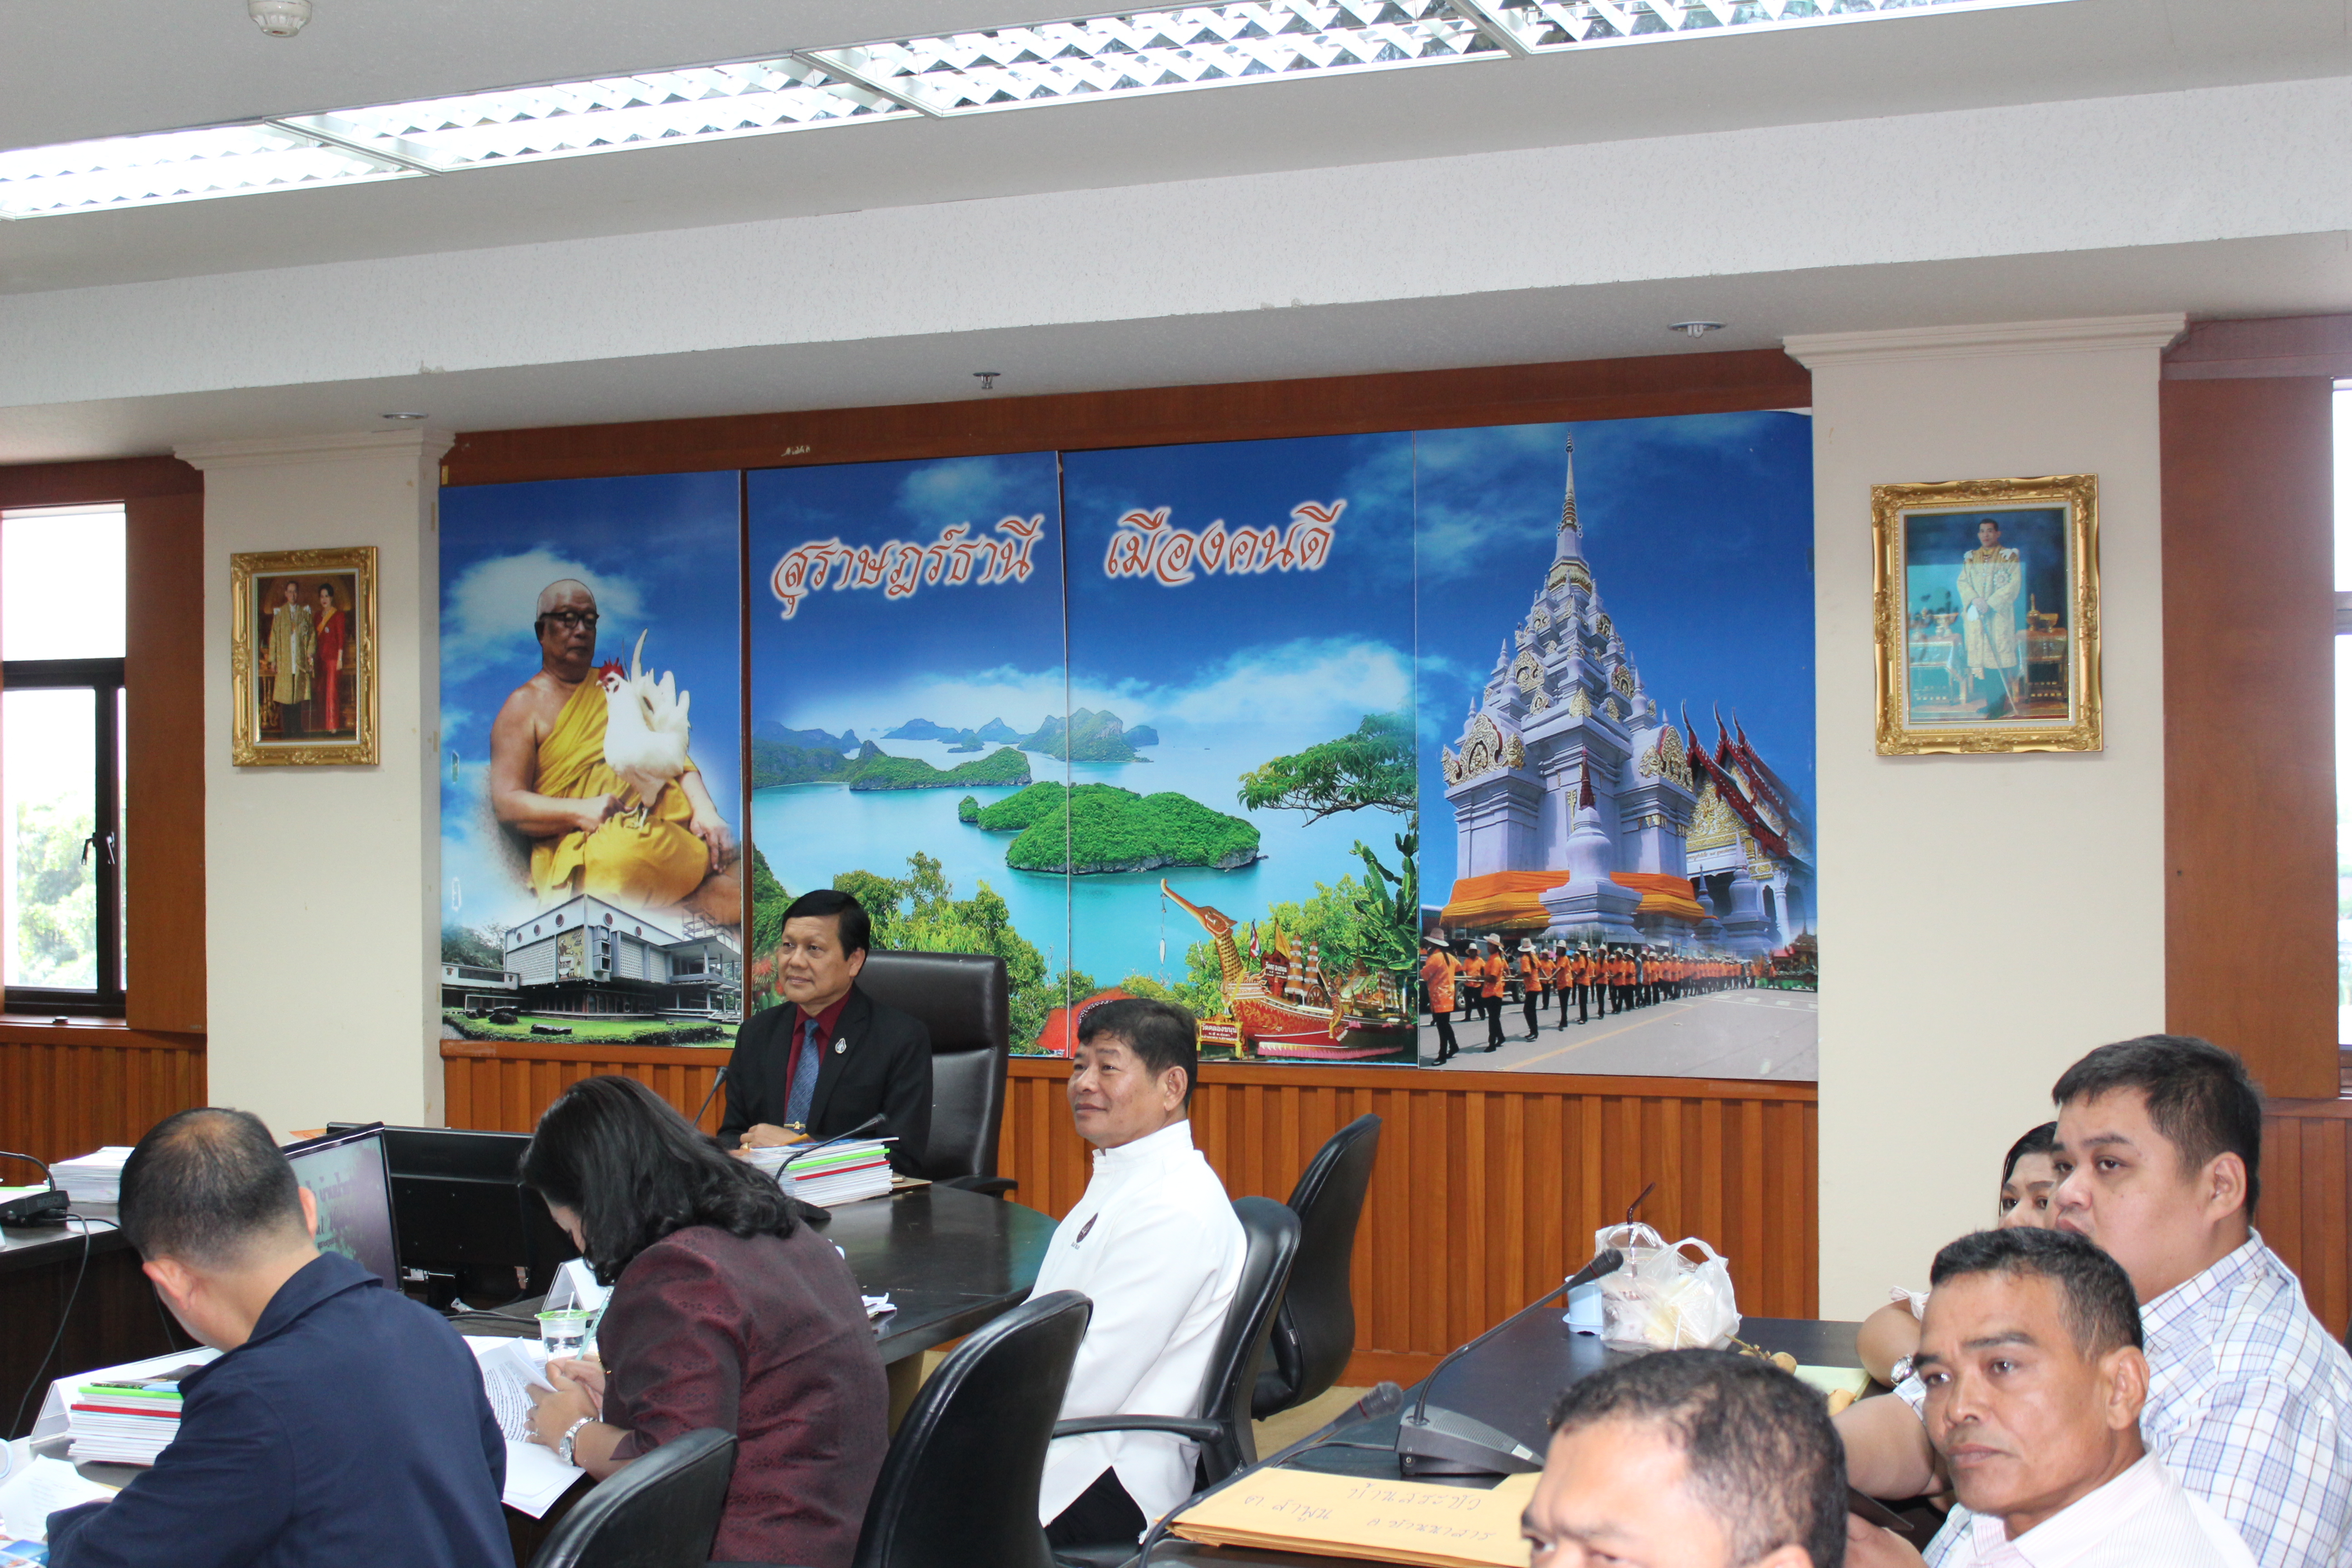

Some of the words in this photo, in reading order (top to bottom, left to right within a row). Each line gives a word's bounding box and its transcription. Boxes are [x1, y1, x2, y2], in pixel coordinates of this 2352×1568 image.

[772, 516, 1042, 617] สุราษฎร์ธานี
[1106, 501, 1345, 584] เมืองคนดี
[36, 1196, 63, 1208] BOSCH
